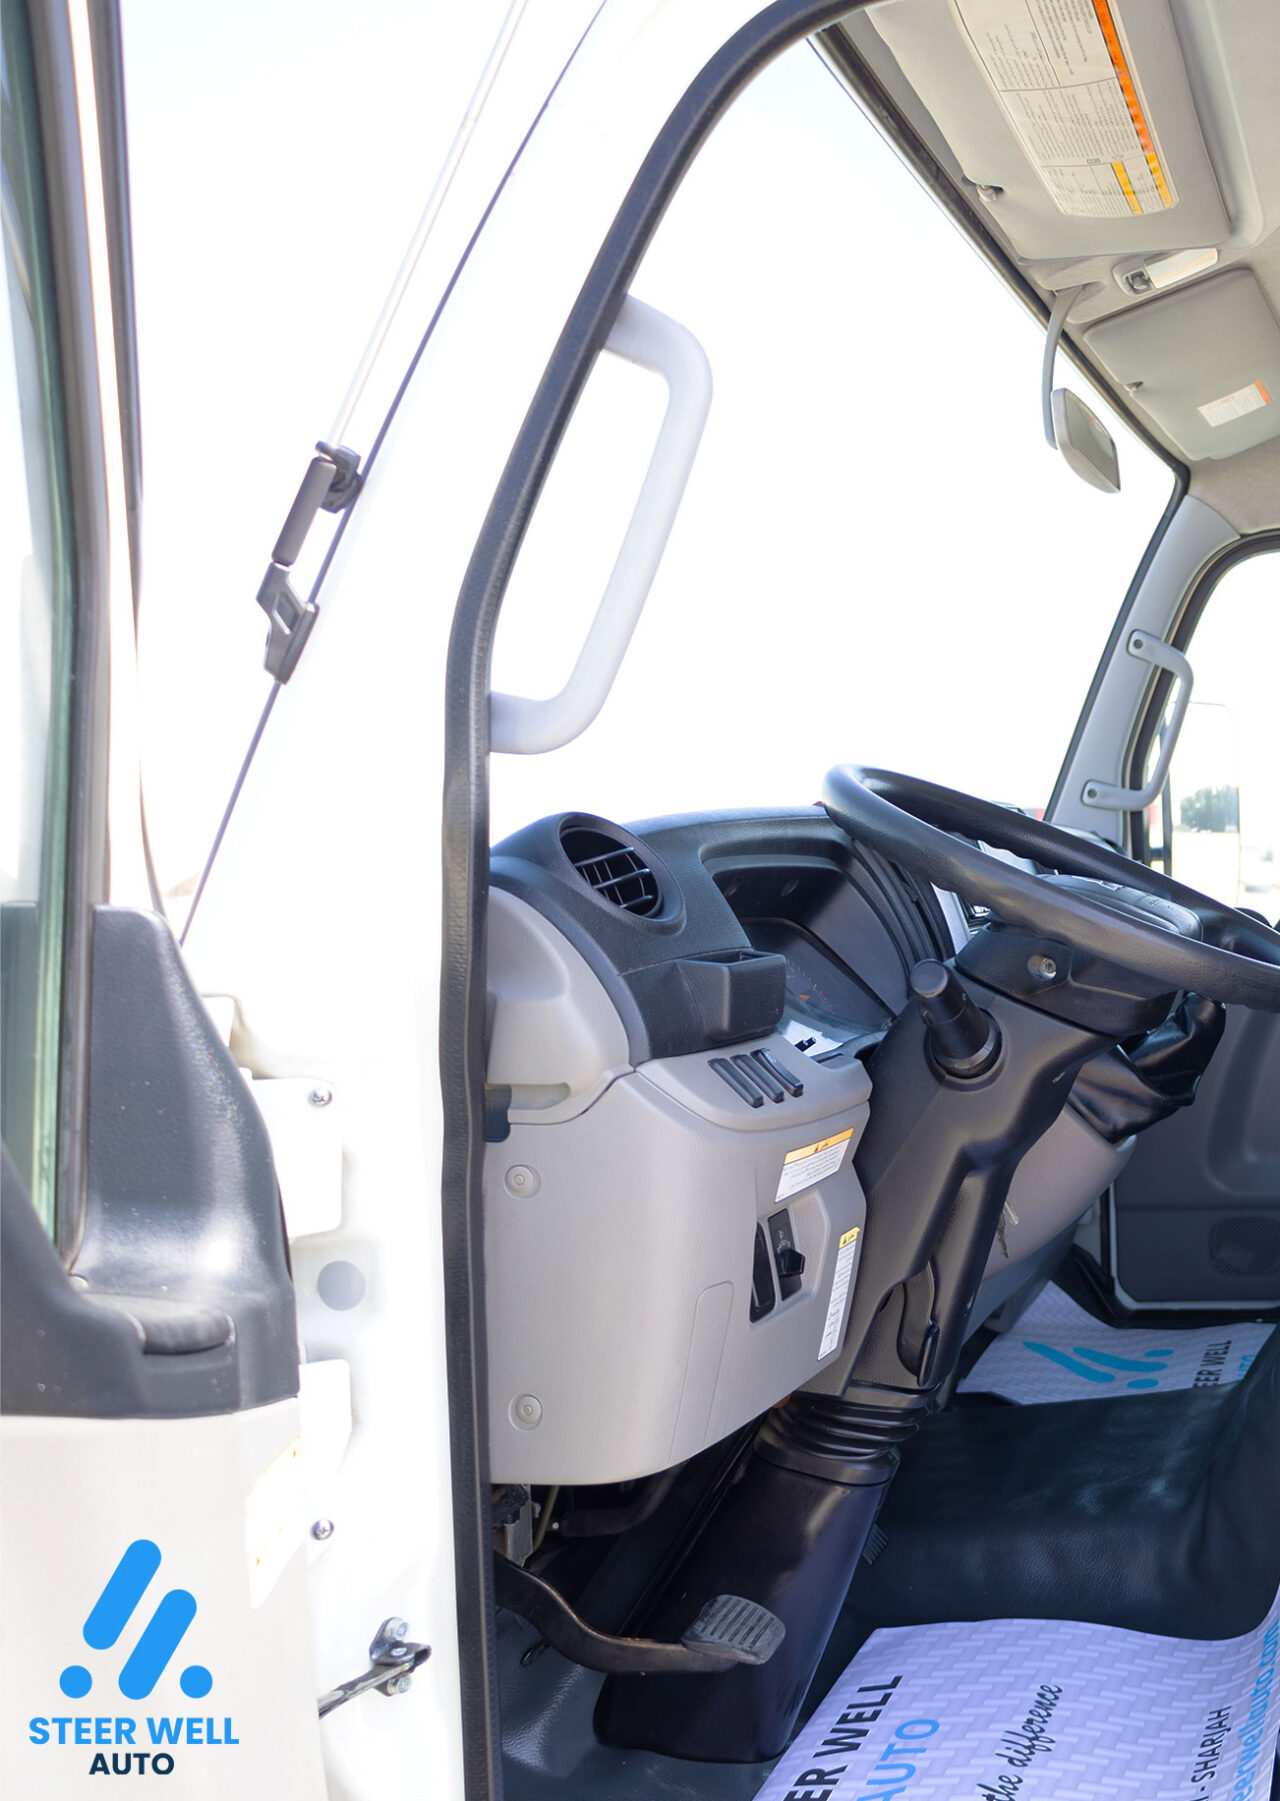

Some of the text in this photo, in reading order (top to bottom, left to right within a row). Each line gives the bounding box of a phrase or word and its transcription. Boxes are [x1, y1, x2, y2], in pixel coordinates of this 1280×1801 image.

[1199, 1339, 1232, 1367] WELL
[812, 1674, 903, 1758] WELL
[994, 1684, 1063, 1768] difference
[1190, 1705, 1232, 1783] SHARJAH
